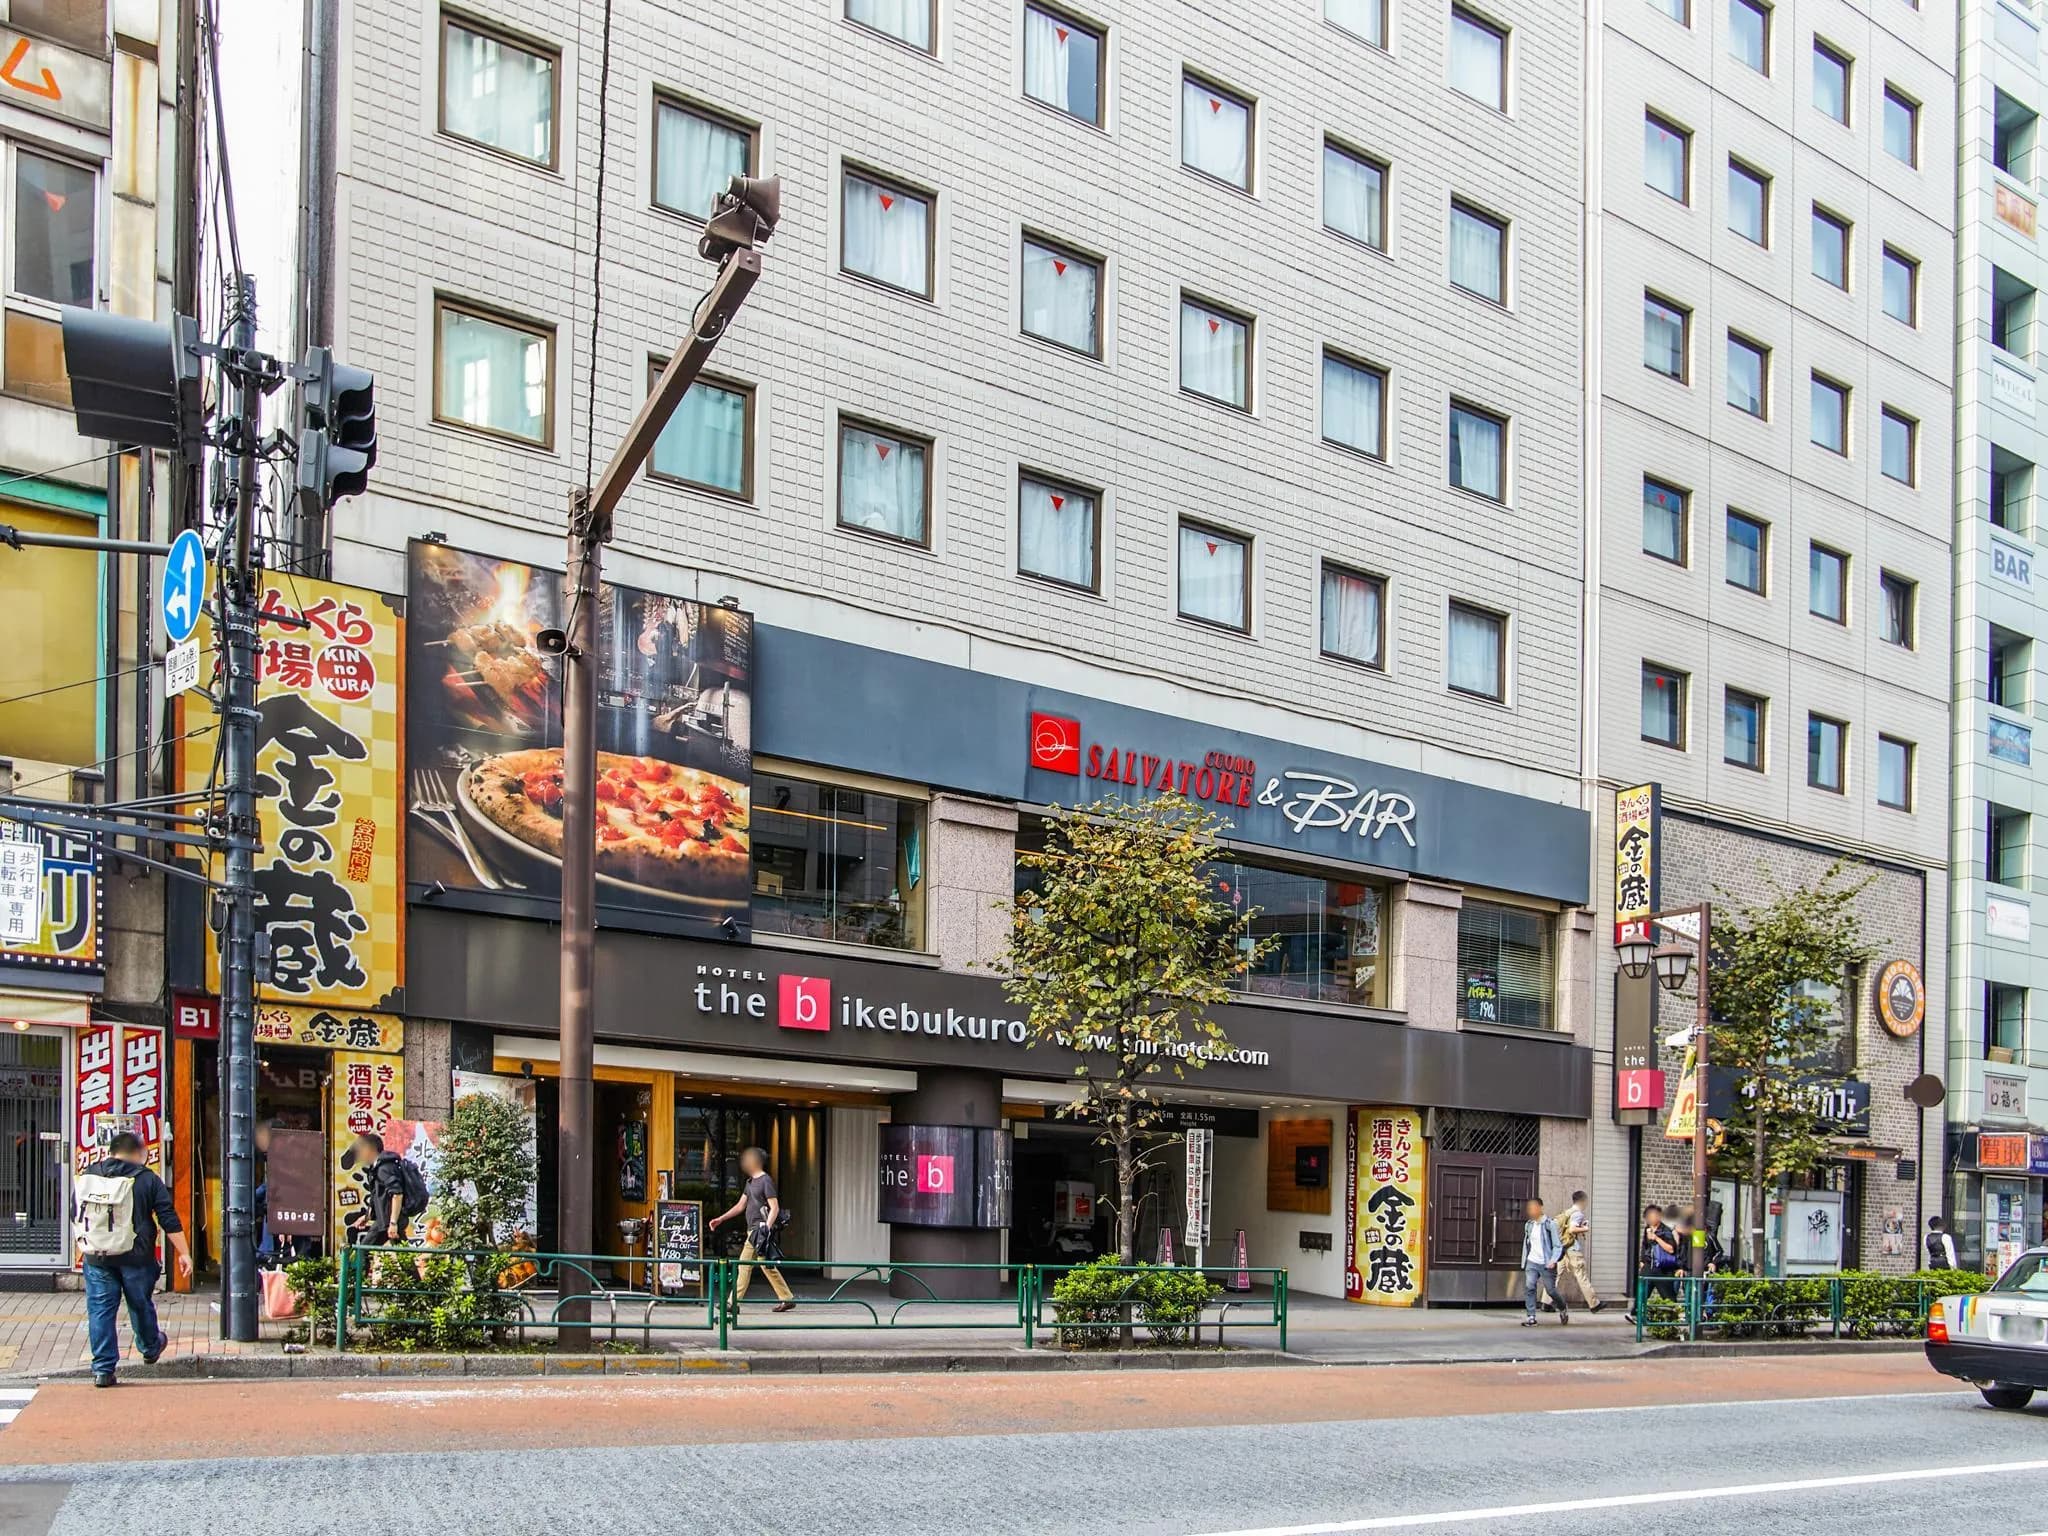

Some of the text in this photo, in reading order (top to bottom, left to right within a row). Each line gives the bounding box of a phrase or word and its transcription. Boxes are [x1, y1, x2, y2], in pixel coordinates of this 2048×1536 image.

[1993, 548, 2030, 585] BAR
[213, 589, 374, 646] んくら
[324, 648, 361, 663] KIN
[334, 665, 357, 675] no
[321, 677, 371, 693] KURA
[1204, 751, 1256, 774] CUOMO
[1085, 744, 1416, 848] SALVATORE & BAR
[256, 694, 368, 993] 金の蔵
[0, 850, 17, 898] 自転車
[20, 851, 36, 901] 歩行者
[1618, 825, 1650, 911] 金の蔵
[8, 901, 25, 934] 専用
[697, 965, 766, 982] HOTEL
[180, 1006, 210, 1028] B1
[309, 1011, 381, 1048] 金の蔵
[694, 982, 766, 1018] the
[842, 996, 1027, 1044] ikebukuro
[1624, 1055, 1645, 1066] the
[348, 1064, 373, 1111] 酒場
[351, 1111, 368, 1119] KIN
[1372, 1119, 1393, 1160] 酒場
[1395, 1119, 1411, 1183] きんくら
[880, 1165, 908, 1187] the
[994, 1164, 1012, 1191] th
[1366, 1185, 1416, 1293] 金の蔵
[1346, 1272, 1360, 1291] B1
